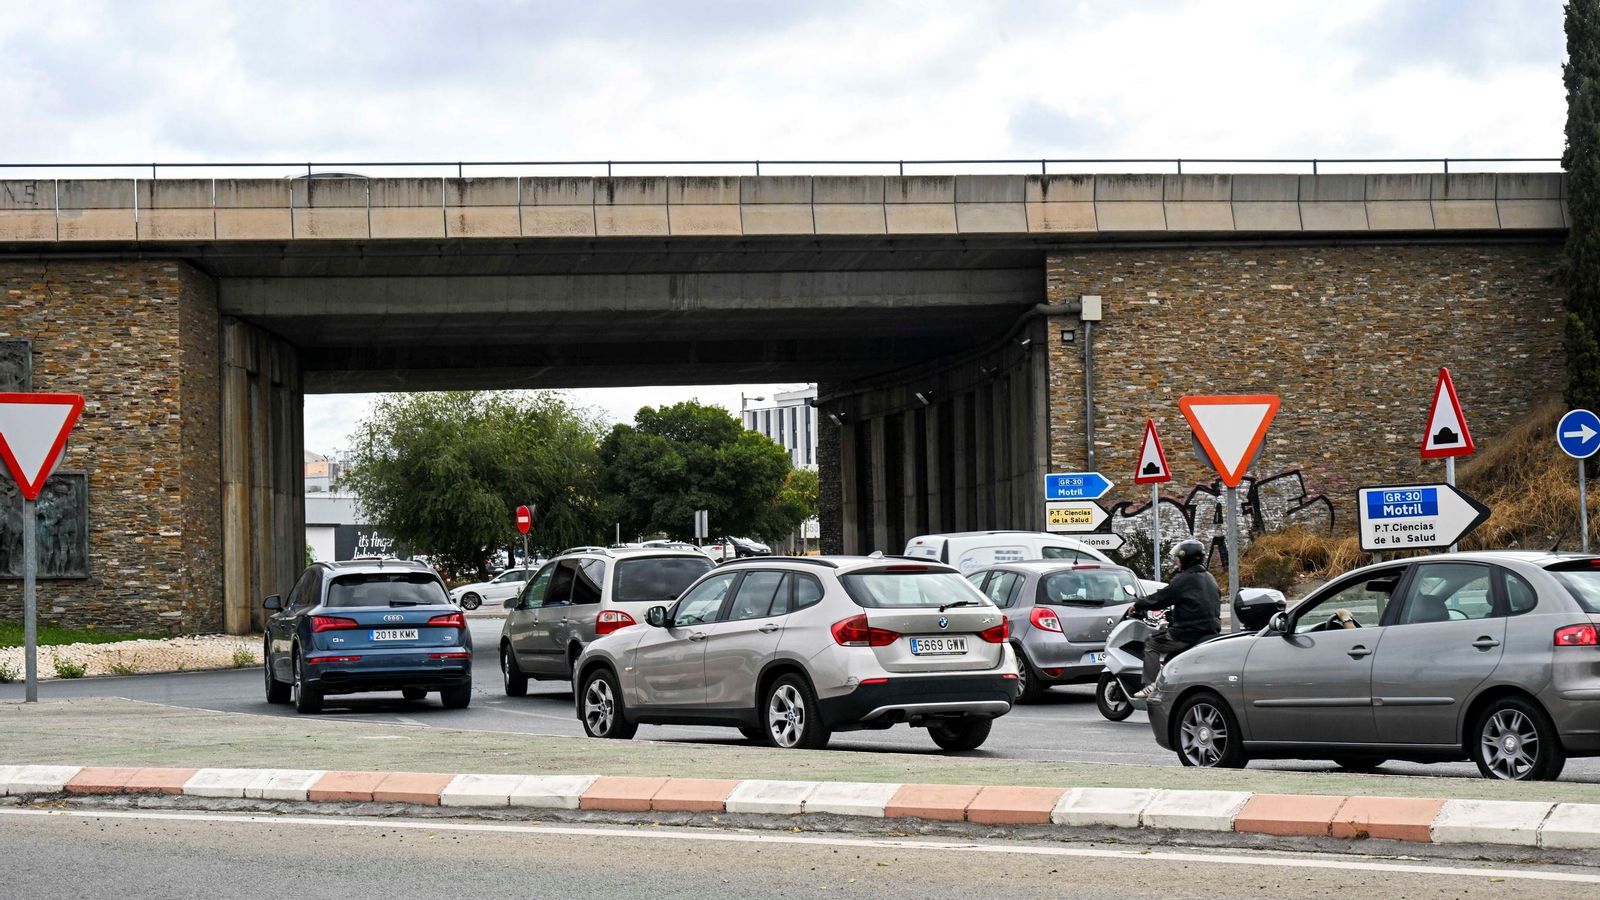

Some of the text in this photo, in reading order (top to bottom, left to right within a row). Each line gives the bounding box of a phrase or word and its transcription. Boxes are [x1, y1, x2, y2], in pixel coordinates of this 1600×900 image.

[1058, 488, 1083, 496] Motril
[1385, 491, 1421, 502] GR-30
[1383, 504, 1423, 516] Motril
[1374, 533, 1436, 545] de la Salud
[375, 629, 417, 640] 2018 KMK
[917, 639, 965, 651] 5669 GWW
